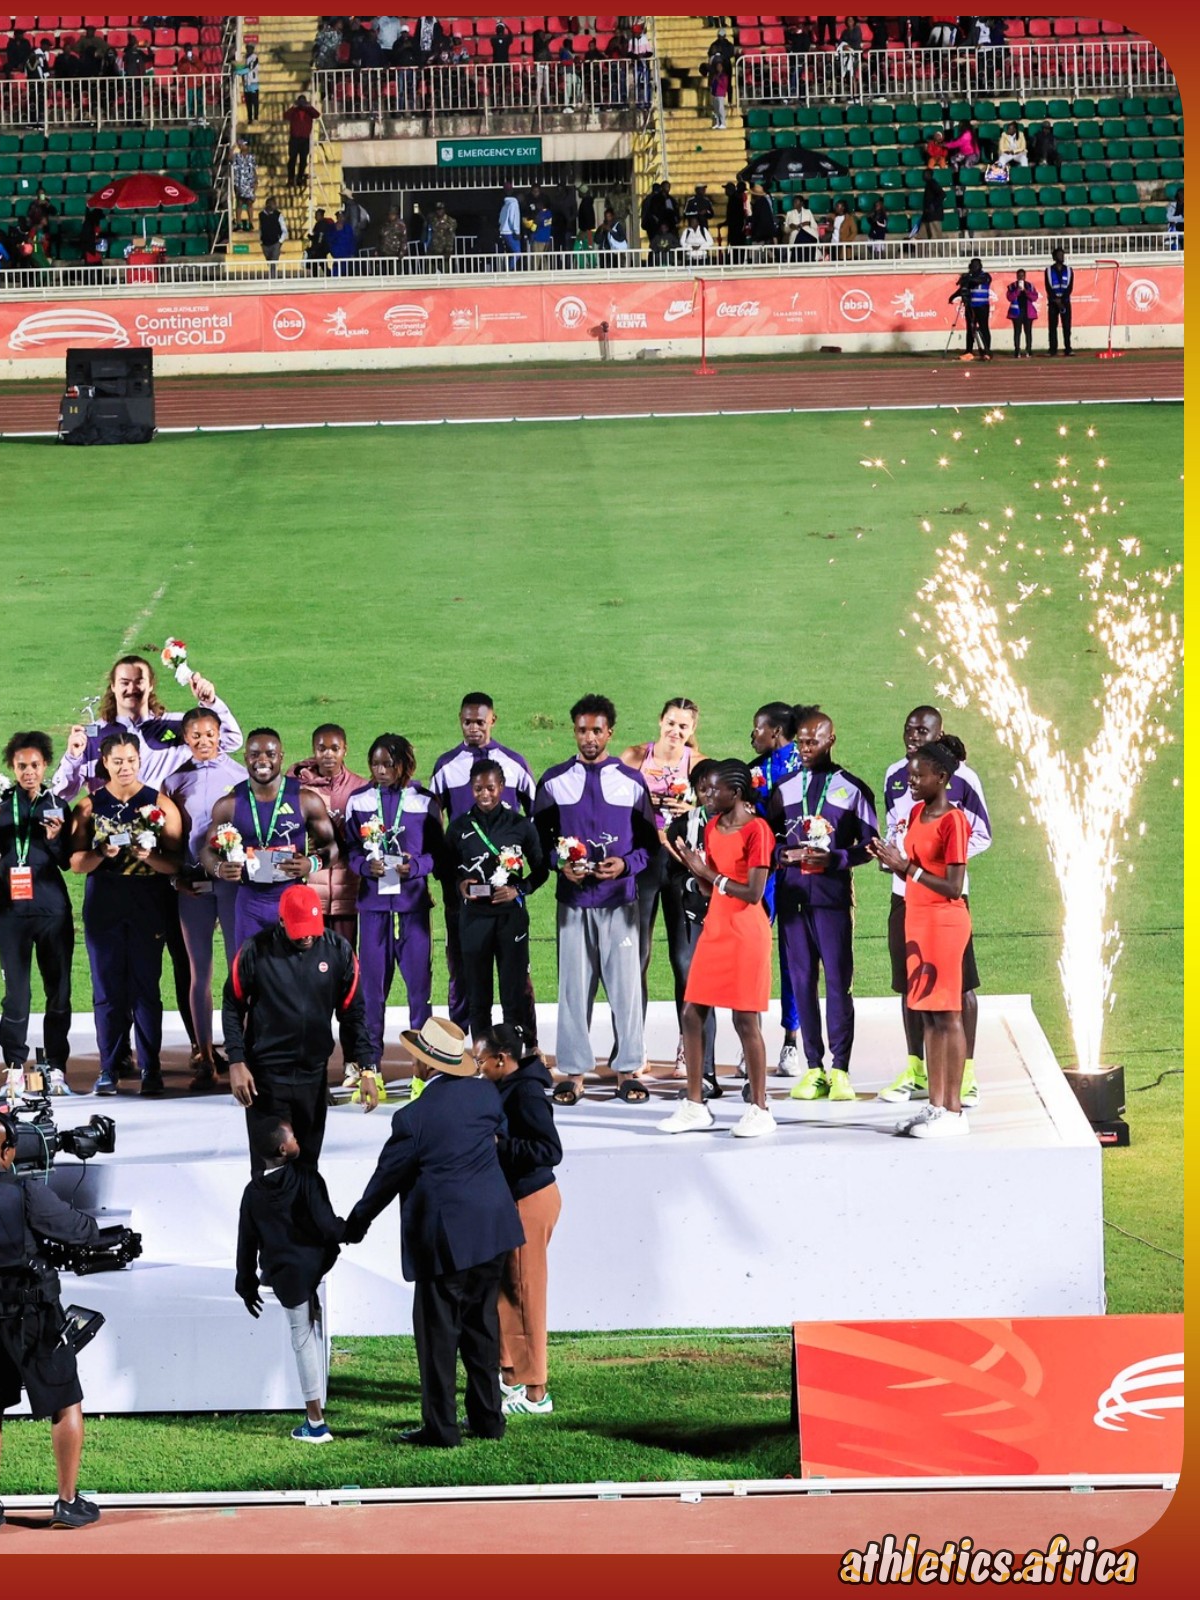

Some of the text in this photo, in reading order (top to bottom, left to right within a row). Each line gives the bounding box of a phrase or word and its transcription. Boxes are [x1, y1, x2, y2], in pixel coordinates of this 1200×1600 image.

[458, 147, 537, 158] EMERGENCY EXIT
[844, 299, 869, 310] absa
[135, 312, 233, 330] Continental
[277, 318, 301, 328] absa
[616, 320, 647, 328] KENYA
